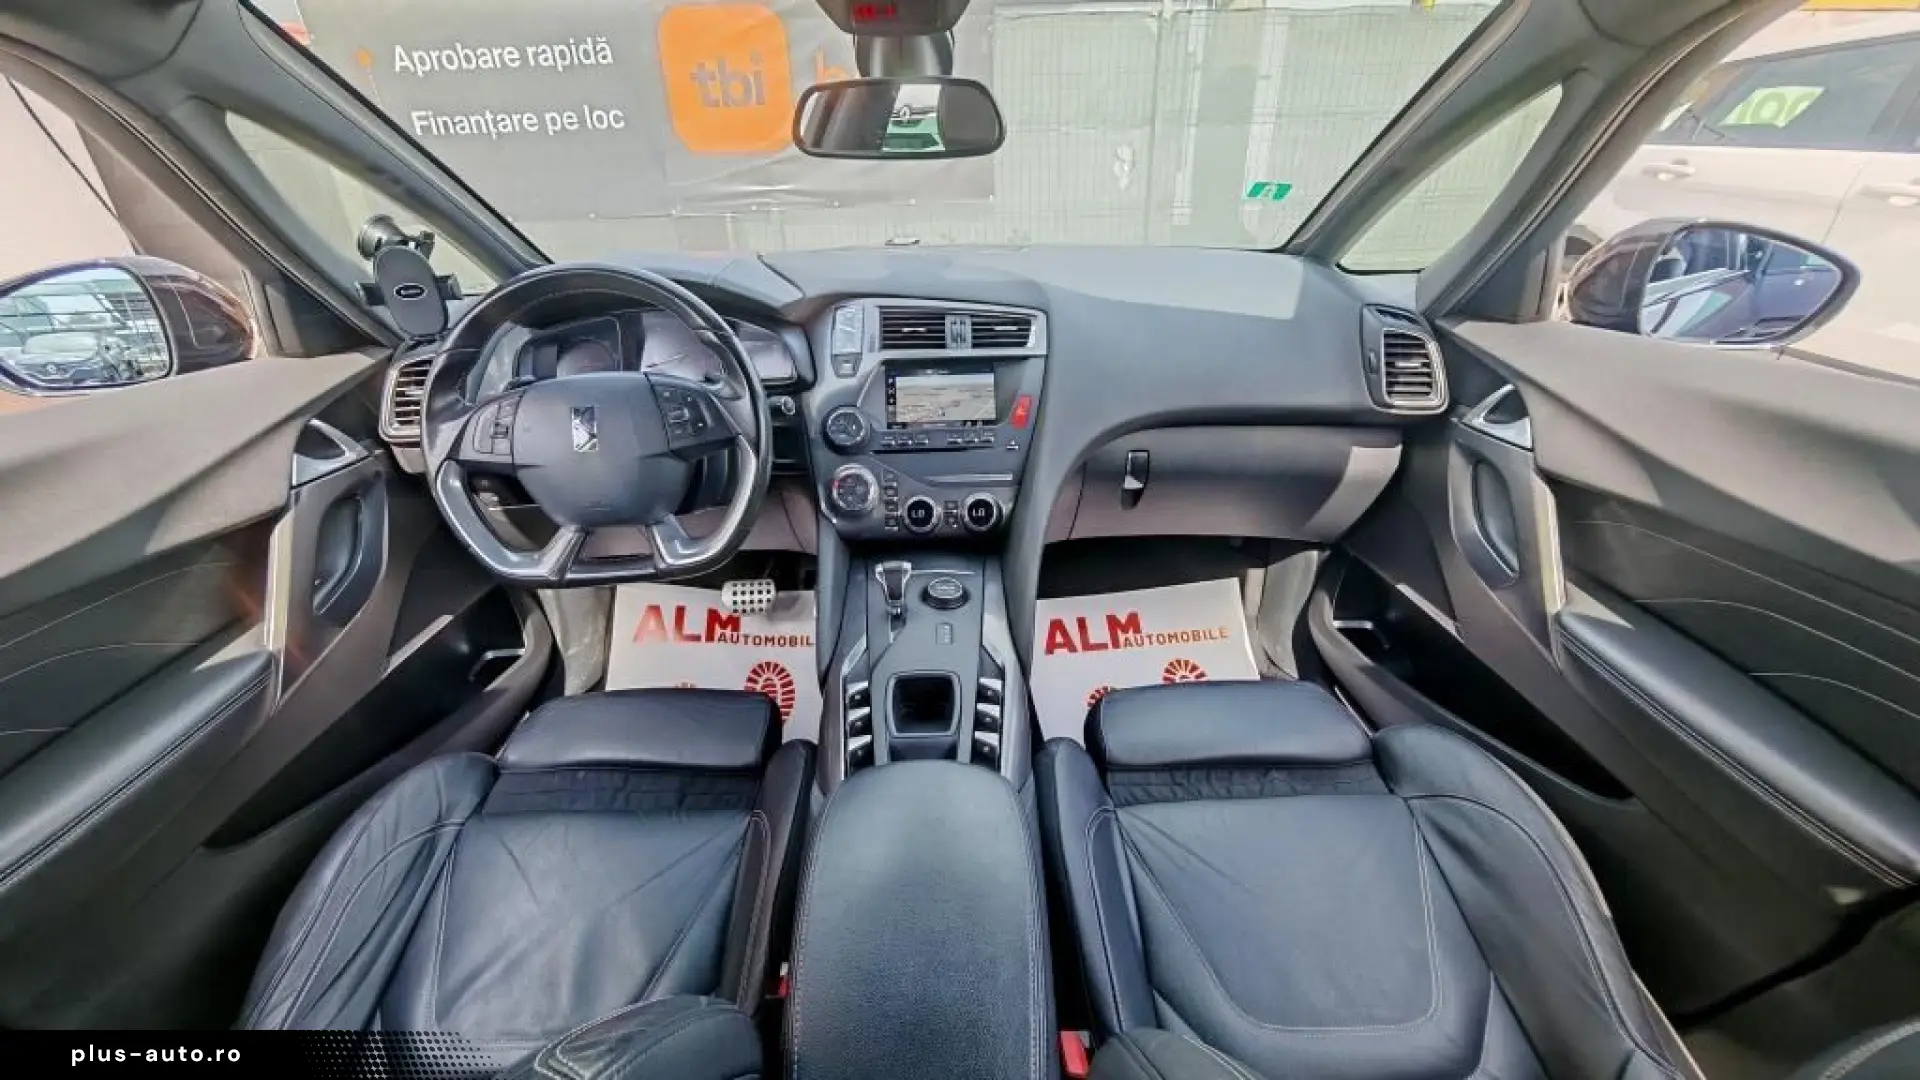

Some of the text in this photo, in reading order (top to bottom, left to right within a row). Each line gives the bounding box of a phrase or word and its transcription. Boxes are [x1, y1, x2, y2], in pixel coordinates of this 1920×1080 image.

[394, 35, 614, 78] Aprobare rapidă
[690, 51, 766, 108] tbi
[410, 104, 626, 140] Finanțare pe loc
[632, 604, 742, 644] ALM
[1044, 611, 1230, 656] ALM AUTOMOBILE
